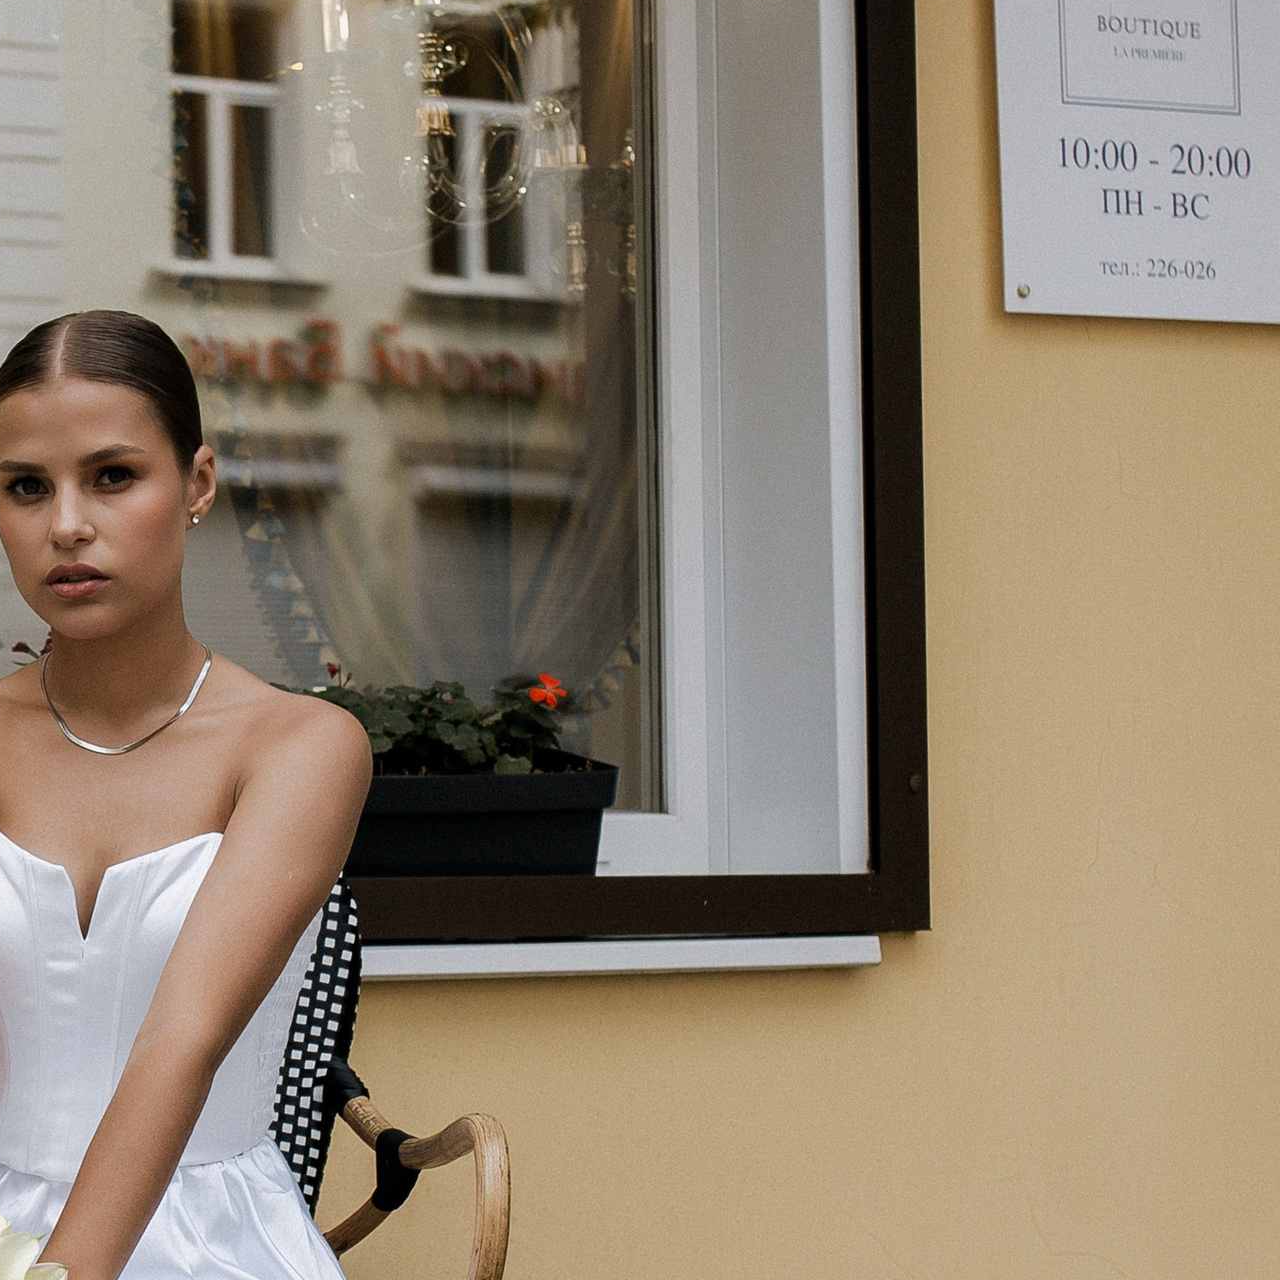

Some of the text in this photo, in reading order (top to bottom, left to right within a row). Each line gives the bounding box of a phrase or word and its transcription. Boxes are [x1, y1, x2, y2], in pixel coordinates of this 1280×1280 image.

[1097, 15, 1202, 41] BOUTIQUE
[1059, 136, 1138, 173] 10:00
[1170, 143, 1252, 180] 20:00
[1101, 187, 1145, 217] ПН
[1171, 191, 1211, 221] ВС
[1147, 258, 1217, 281] 226-026
